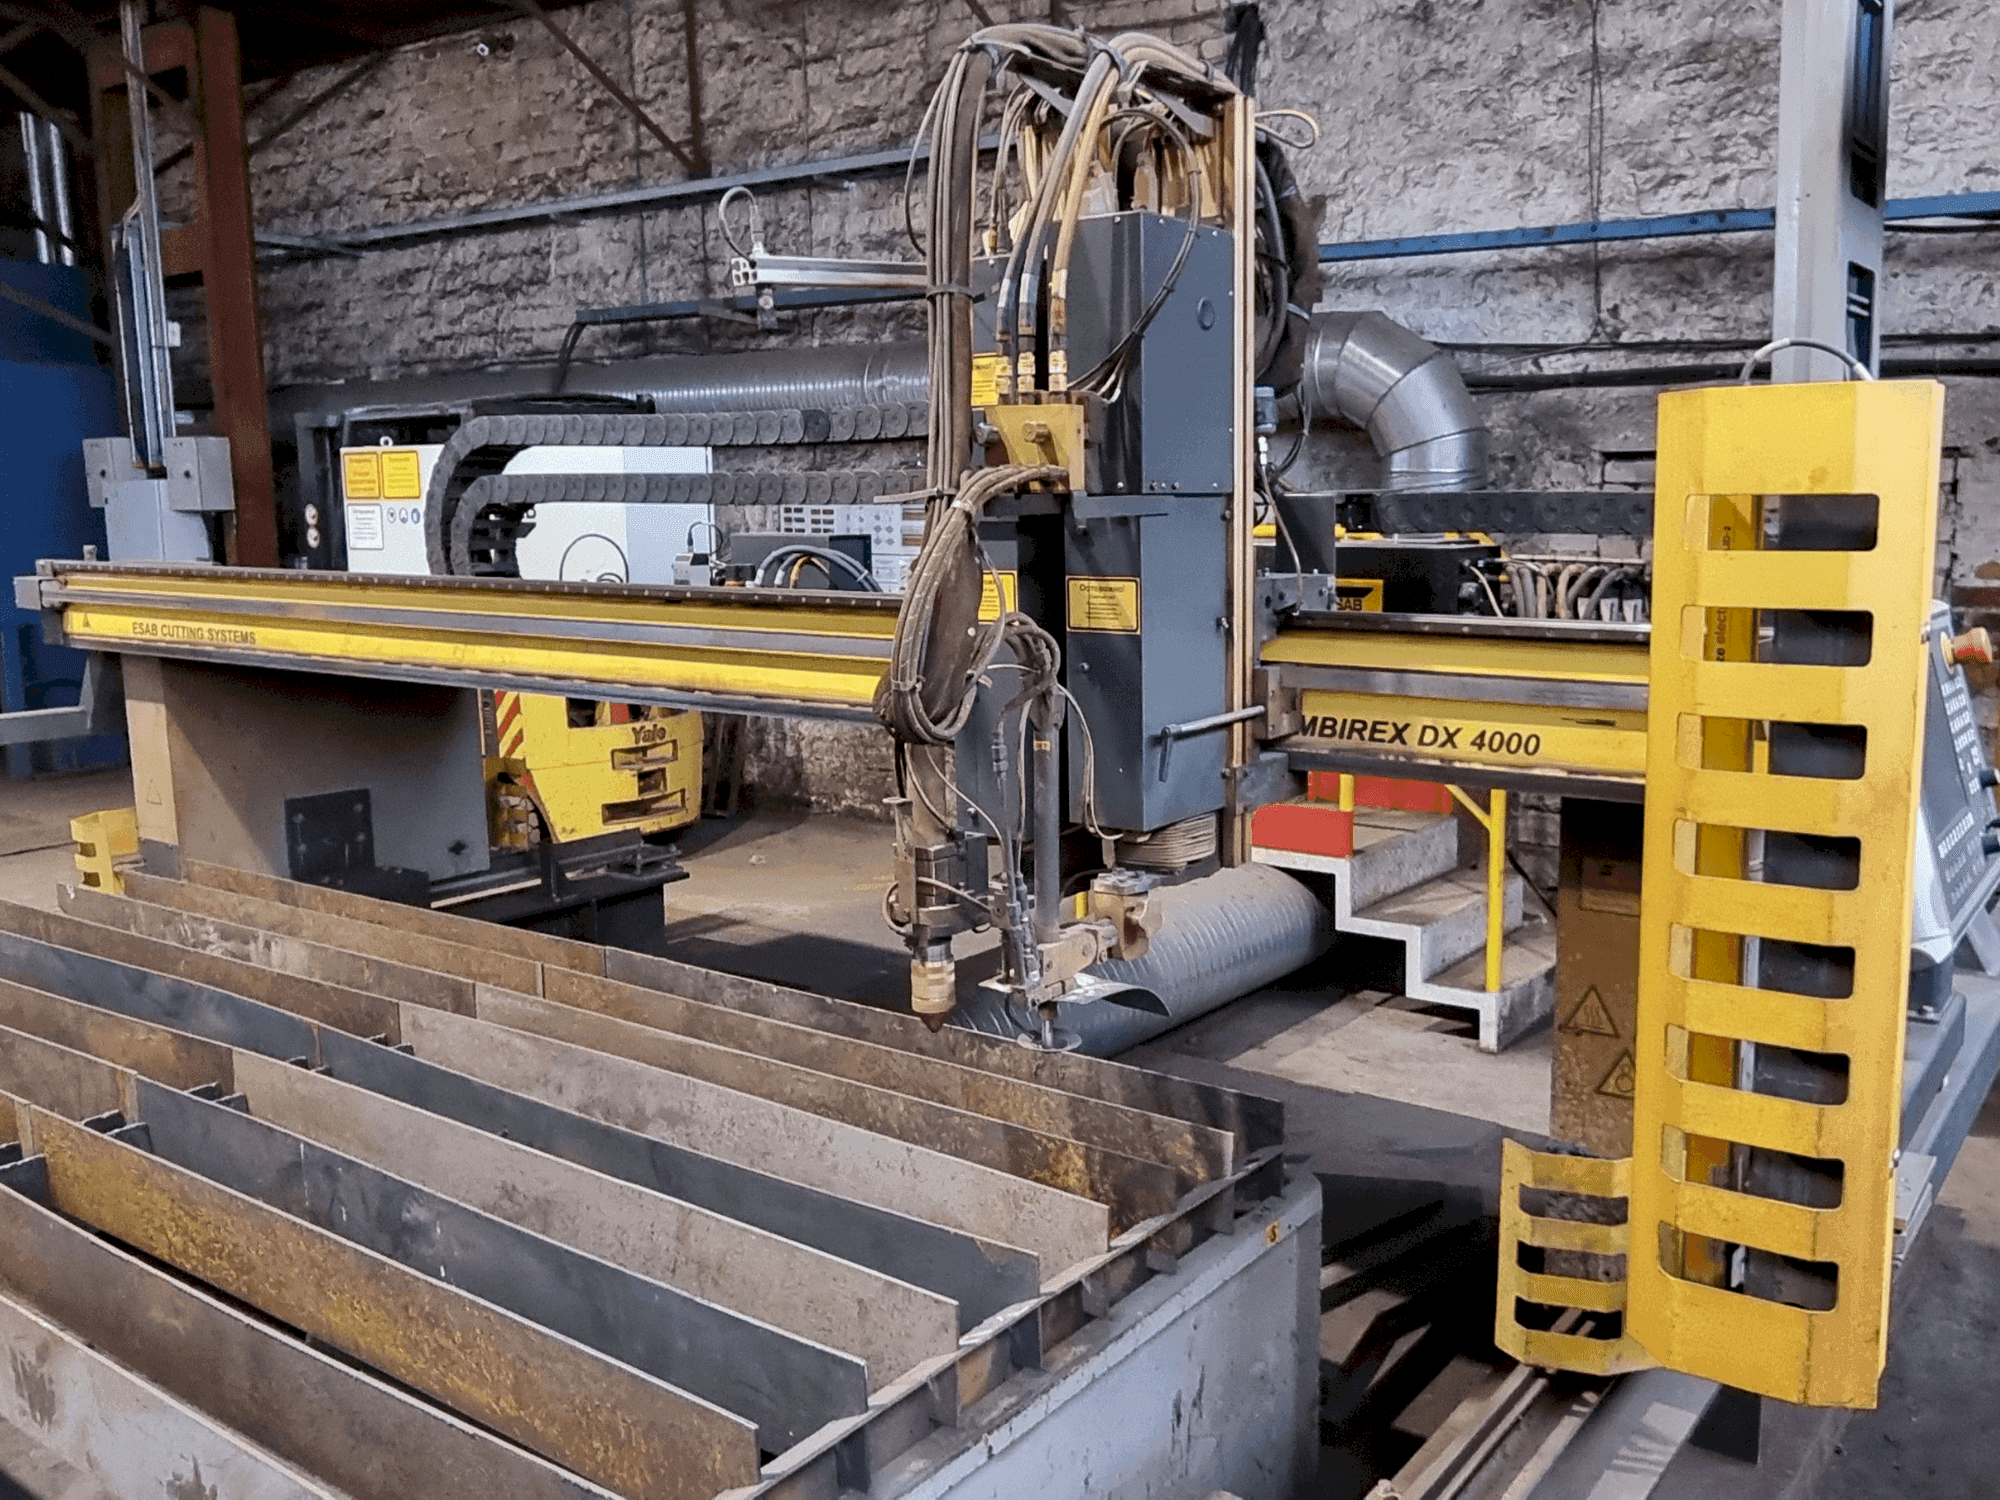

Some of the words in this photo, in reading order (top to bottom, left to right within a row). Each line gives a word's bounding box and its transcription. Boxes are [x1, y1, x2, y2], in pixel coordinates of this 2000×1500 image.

[132, 622, 158, 636] ESAB
[160, 624, 204, 641] CUTTING
[207, 628, 257, 645] SYSTEMS
[631, 723, 667, 745] Yale
[1417, 724, 1463, 749] DX
[1470, 729, 1541, 757] 4000
